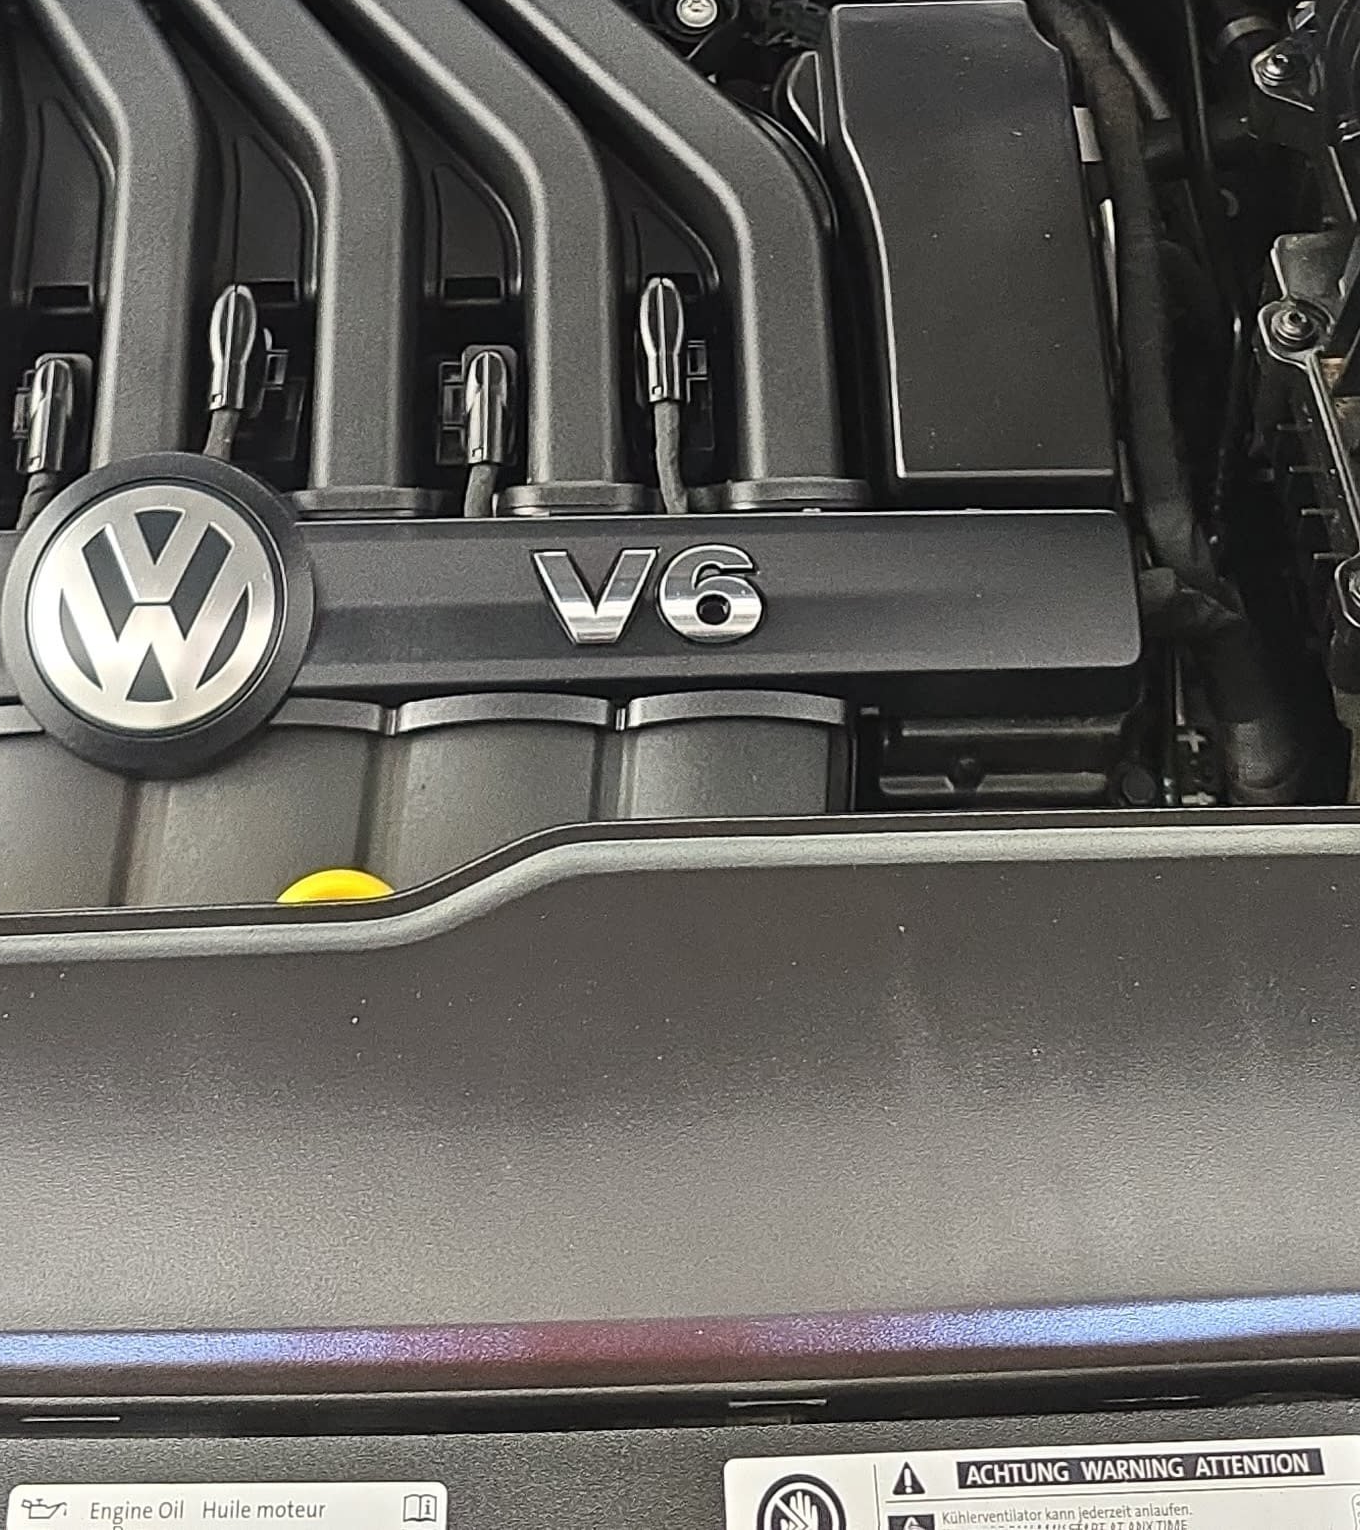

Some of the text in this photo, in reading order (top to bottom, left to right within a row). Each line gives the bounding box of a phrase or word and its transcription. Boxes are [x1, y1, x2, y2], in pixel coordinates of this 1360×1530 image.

[33, 485, 764, 730] VW V6
[965, 1452, 1310, 1486] ACHTUNG WARNING ATTENTION
[89, 1500, 185, 1525] Engine Oil
[202, 1499, 326, 1520] Huile moteur
[942, 1503, 1193, 1525] Kühlerventilator kann jederzeit anlaufen.
